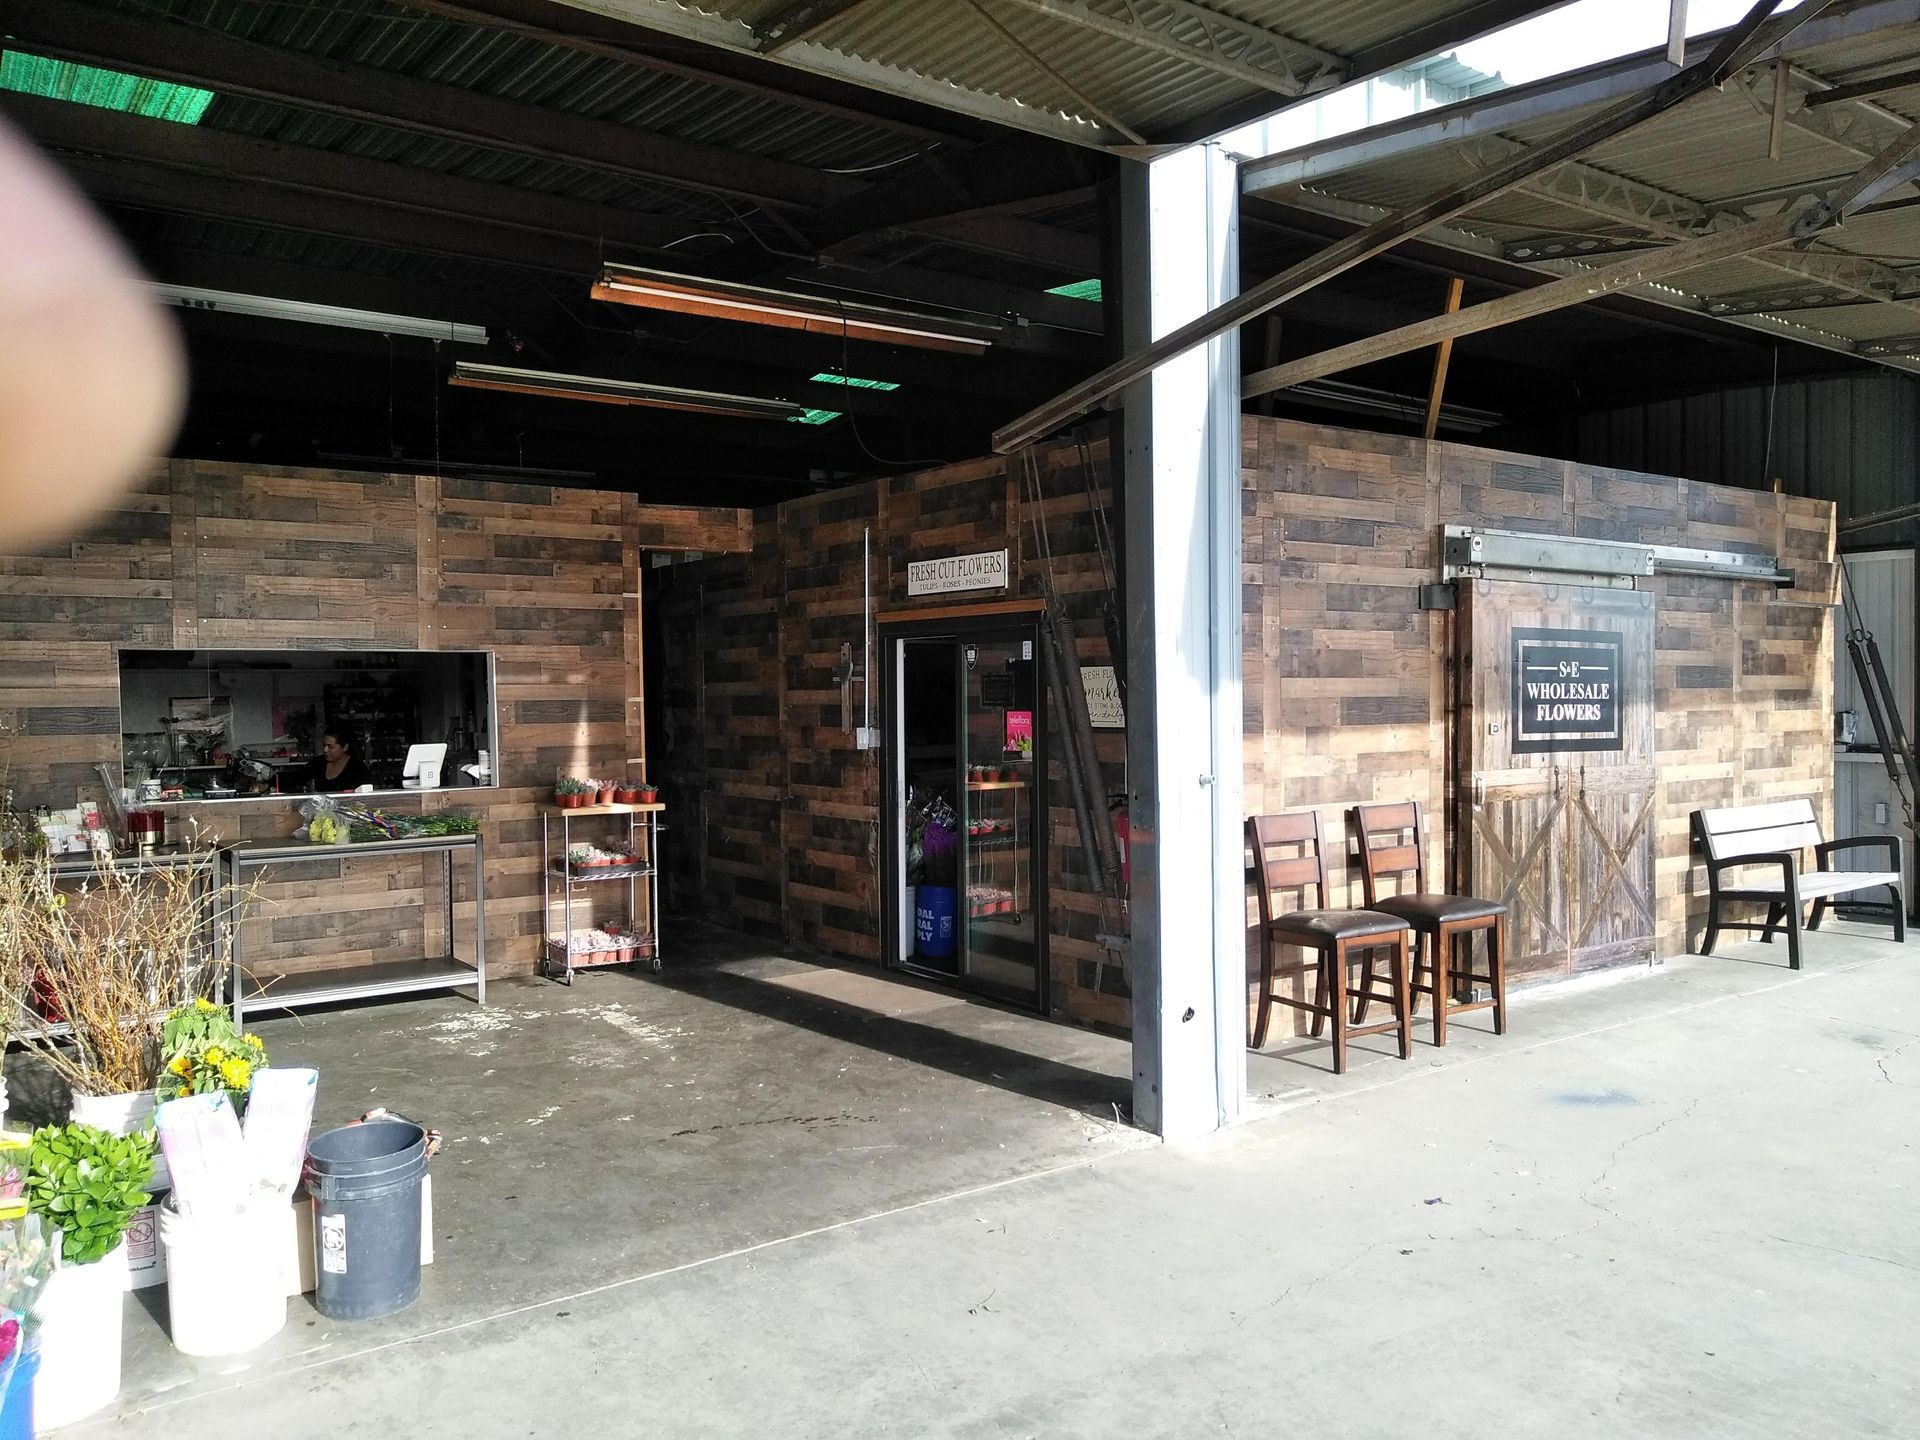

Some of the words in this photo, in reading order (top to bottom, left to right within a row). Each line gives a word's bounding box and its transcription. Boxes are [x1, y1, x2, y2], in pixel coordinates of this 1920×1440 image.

[910, 563, 937, 582] FRESH
[938, 561, 956, 580] CUT
[958, 554, 1002, 577] FLOWERS
[919, 582, 939, 591] TULIPS
[942, 580, 961, 589] ROSES
[965, 577, 991, 586] PEONIES
[1081, 670, 1101, 681] RESH
[1559, 661, 1580, 678] S&E
[1526, 682, 1610, 700] WHOLESALE
[1536, 703, 1601, 721] FLOWERS
